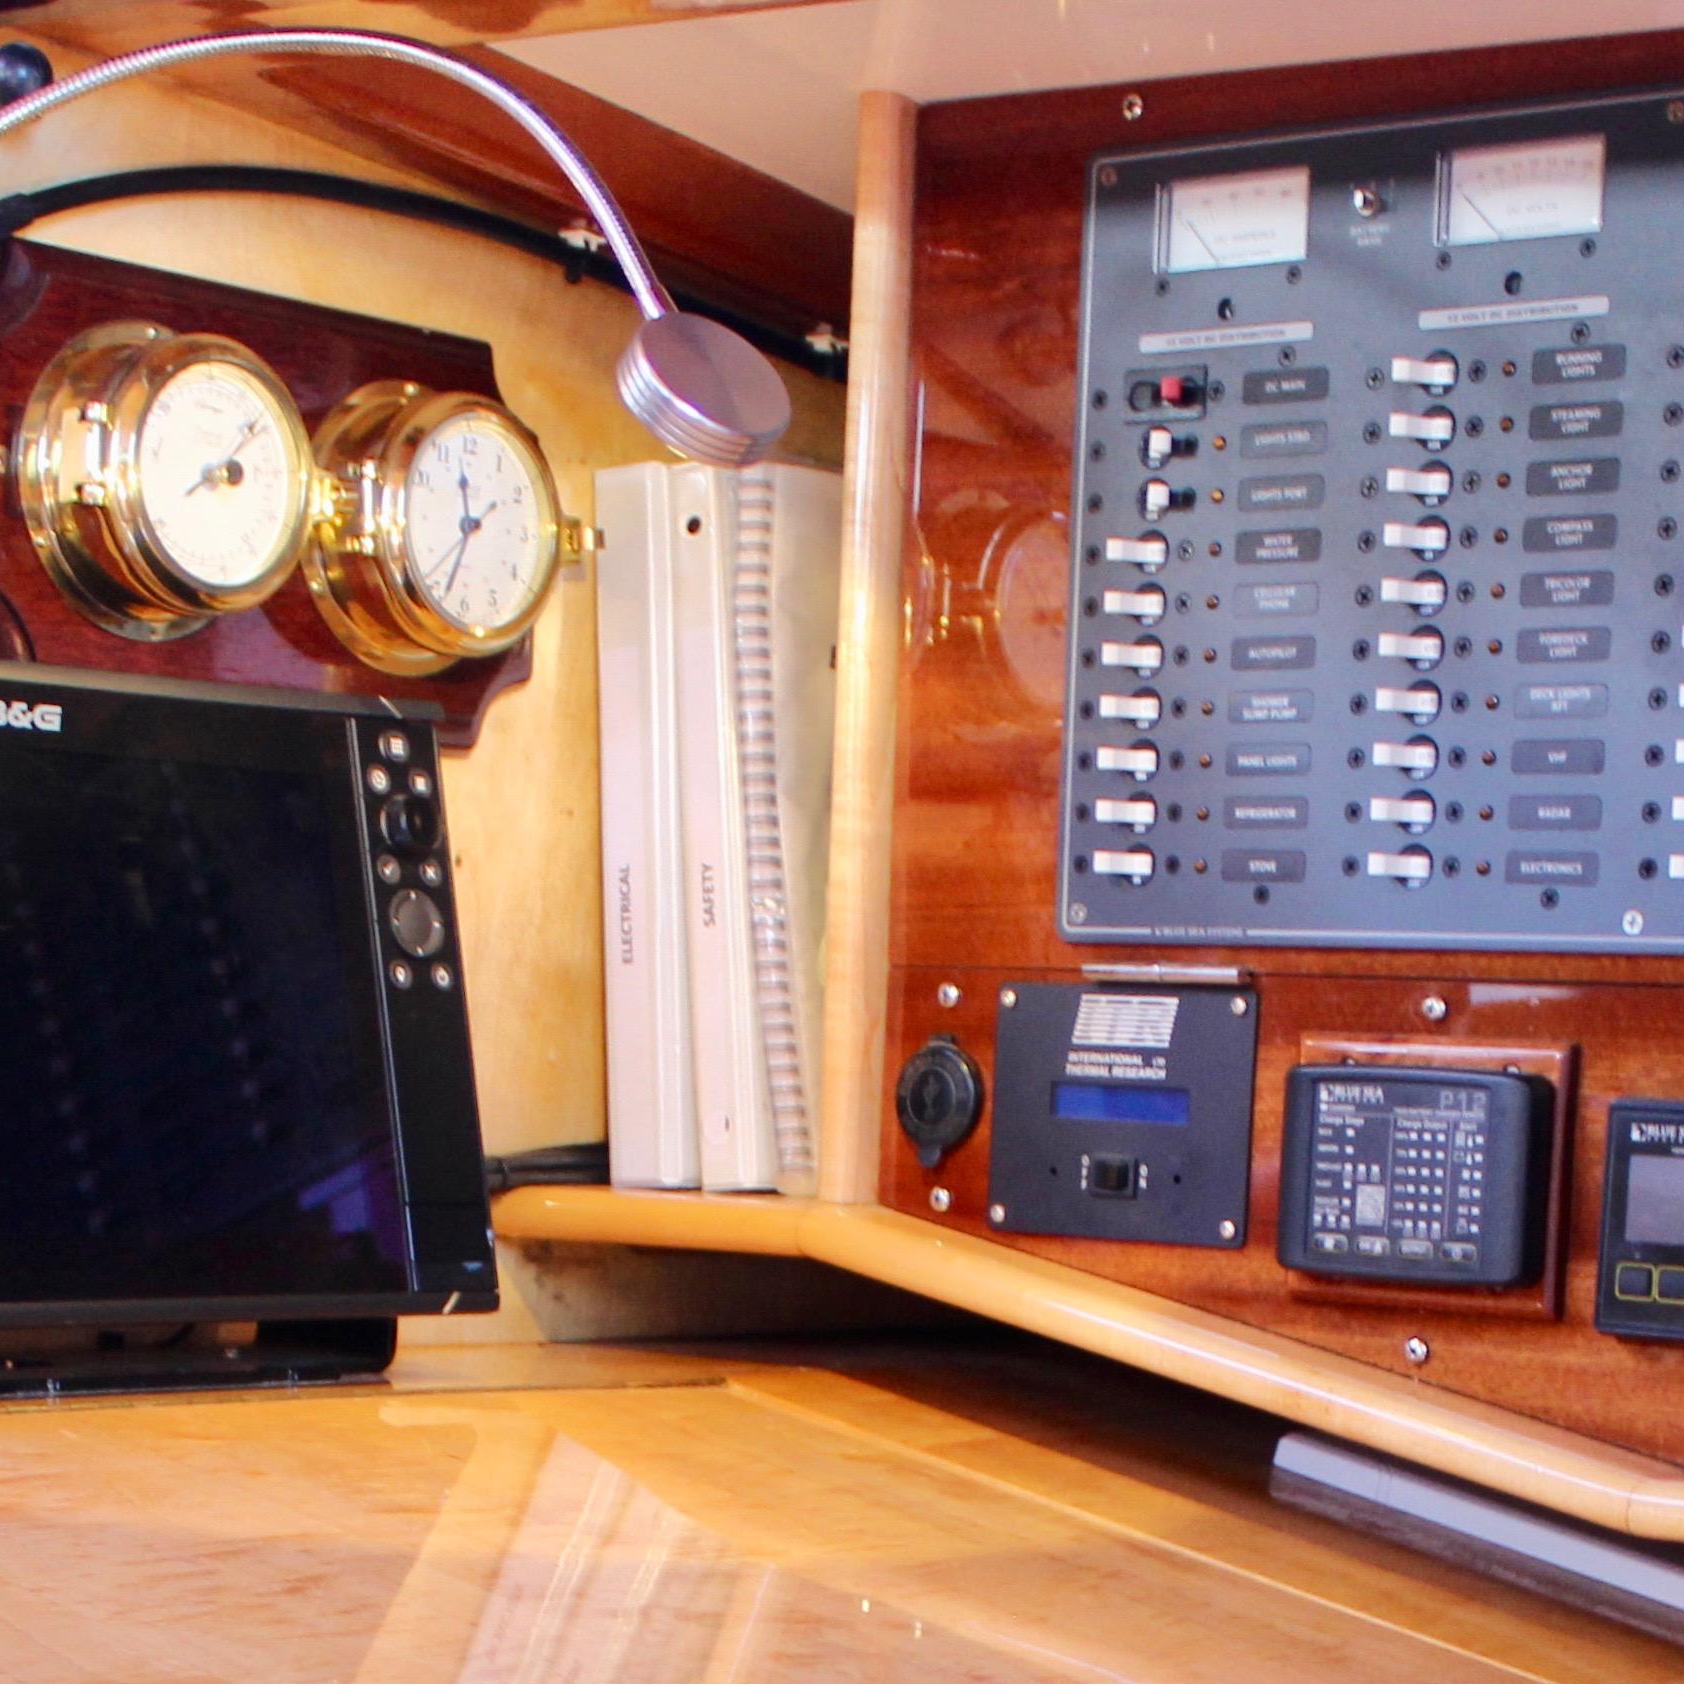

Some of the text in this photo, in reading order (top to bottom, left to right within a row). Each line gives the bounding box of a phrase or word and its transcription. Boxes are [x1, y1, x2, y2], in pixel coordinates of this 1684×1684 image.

[1550, 464, 1593, 477] ANCHOR
[1558, 477, 1586, 490] LIGHT
[1555, 533, 1583, 546] LIGHT
[1538, 807, 1571, 819] RADAR
[1520, 861, 1583, 875] ELECTRONICS
[702, 862, 716, 927] SAFETY
[618, 863, 634, 964] ELECTRICAL
[1440, 1090, 1487, 1111] P12
